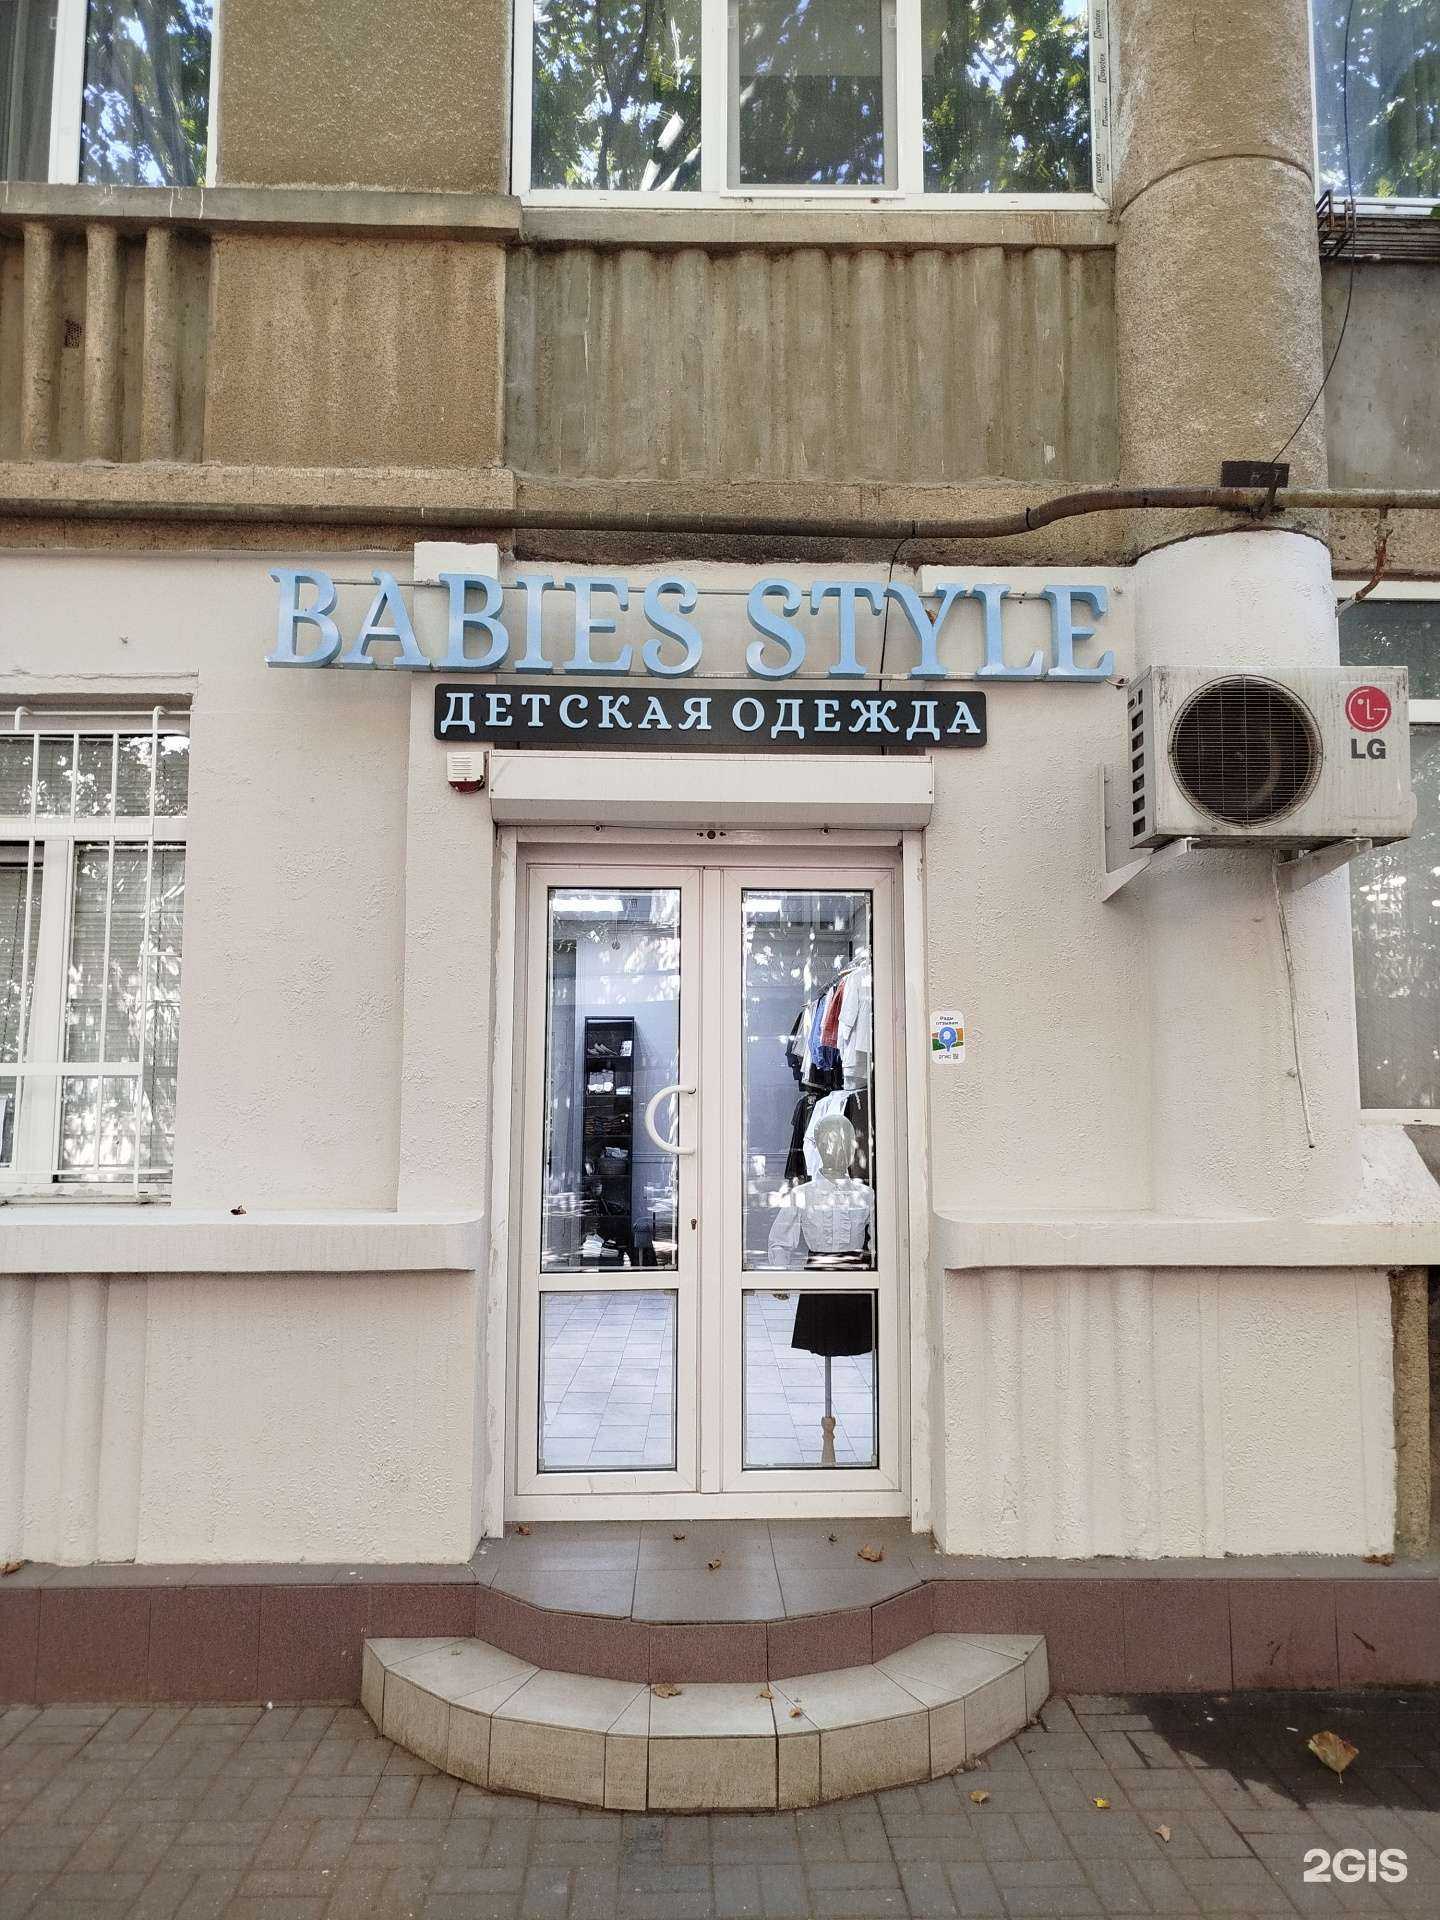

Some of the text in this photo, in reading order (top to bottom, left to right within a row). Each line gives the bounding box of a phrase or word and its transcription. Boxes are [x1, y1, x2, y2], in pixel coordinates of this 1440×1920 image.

[265, 567, 1115, 682] BABIES STYLE
[440, 692, 981, 741] ДЕТСКАЯ ОДЕЖДА
[1351, 738, 1386, 759] LG
